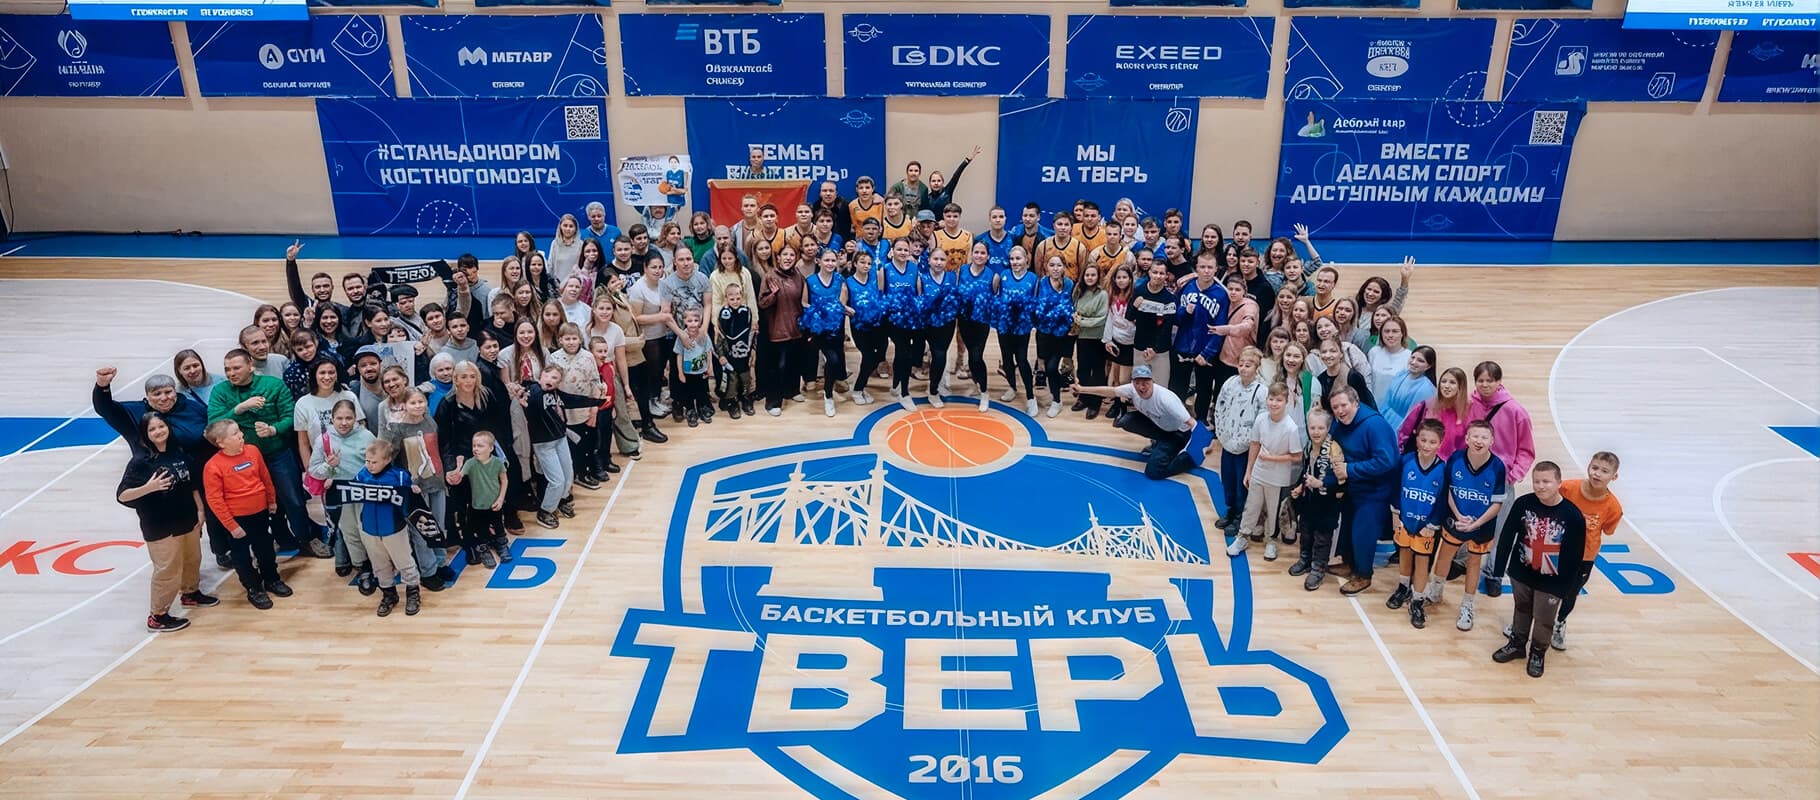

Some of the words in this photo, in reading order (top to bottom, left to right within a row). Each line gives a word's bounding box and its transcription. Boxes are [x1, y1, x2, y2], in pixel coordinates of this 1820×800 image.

[704, 29, 760, 55] ВТБ
[1116, 45, 1222, 60] EXEED
[377, 143, 561, 163] #СТАНЬДОНОРОМ
[1076, 144, 1116, 162] МЫ
[1380, 143, 1470, 160] ВМЕСТЕ
[381, 167, 561, 185] КОСТНОГОМОЗГА
[1041, 166, 1071, 183] ЗА
[1077, 166, 1148, 183] ТВЕРЬ
[1336, 163, 1430, 183] ДЕЛАЕМ
[1435, 165, 1505, 182] СПОРТ
[1290, 184, 1428, 204] ДОСТУПНЫМ
[1434, 186, 1546, 205] КАЖДОМУ
[336, 484, 404, 506] ТВЕРЬ
[760, 603, 1055, 627] БАСКЕТБОЛЬНЫЙ
[1065, 604, 1157, 625] КЛУБ
[632, 623, 1328, 745] ТВЕРЬ
[908, 753, 1024, 784] 2016
